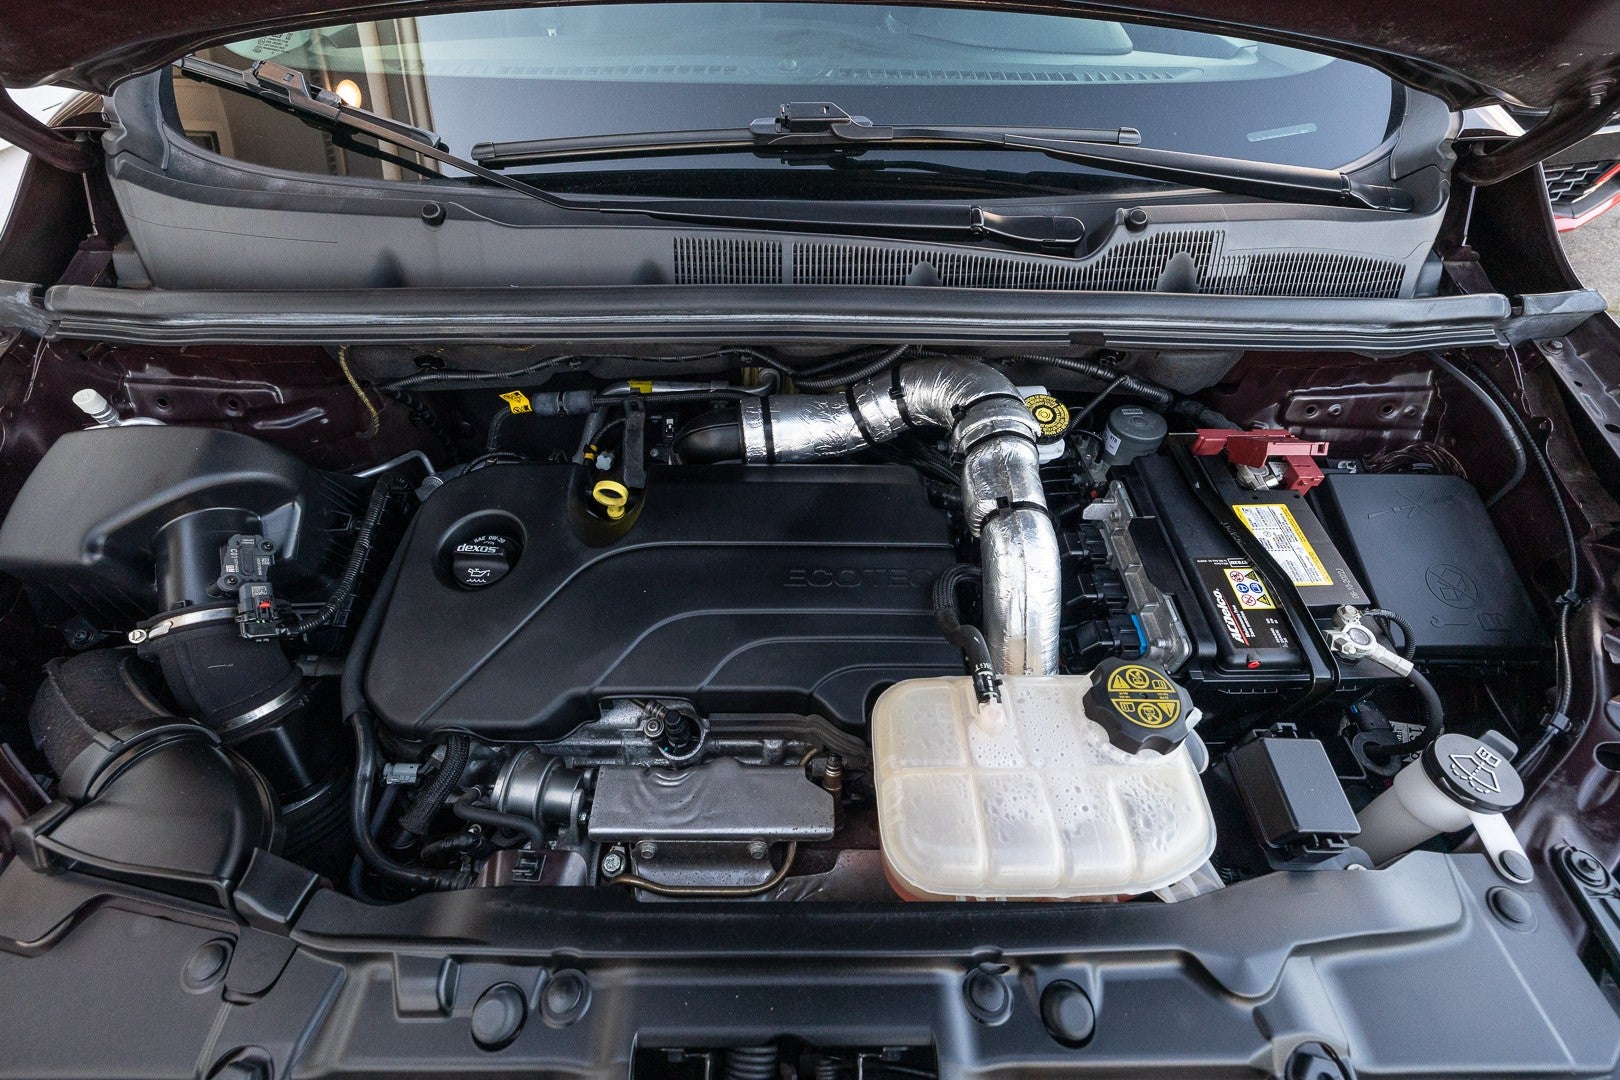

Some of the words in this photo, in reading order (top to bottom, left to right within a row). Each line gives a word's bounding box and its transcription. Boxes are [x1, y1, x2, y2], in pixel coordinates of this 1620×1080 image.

[473, 535, 486, 544] SAE
[488, 535, 506, 544] 0W-20
[456, 543, 497, 553] dexos
[783, 568, 932, 588] ECOTEC
[1212, 588, 1245, 644] ACDelco
